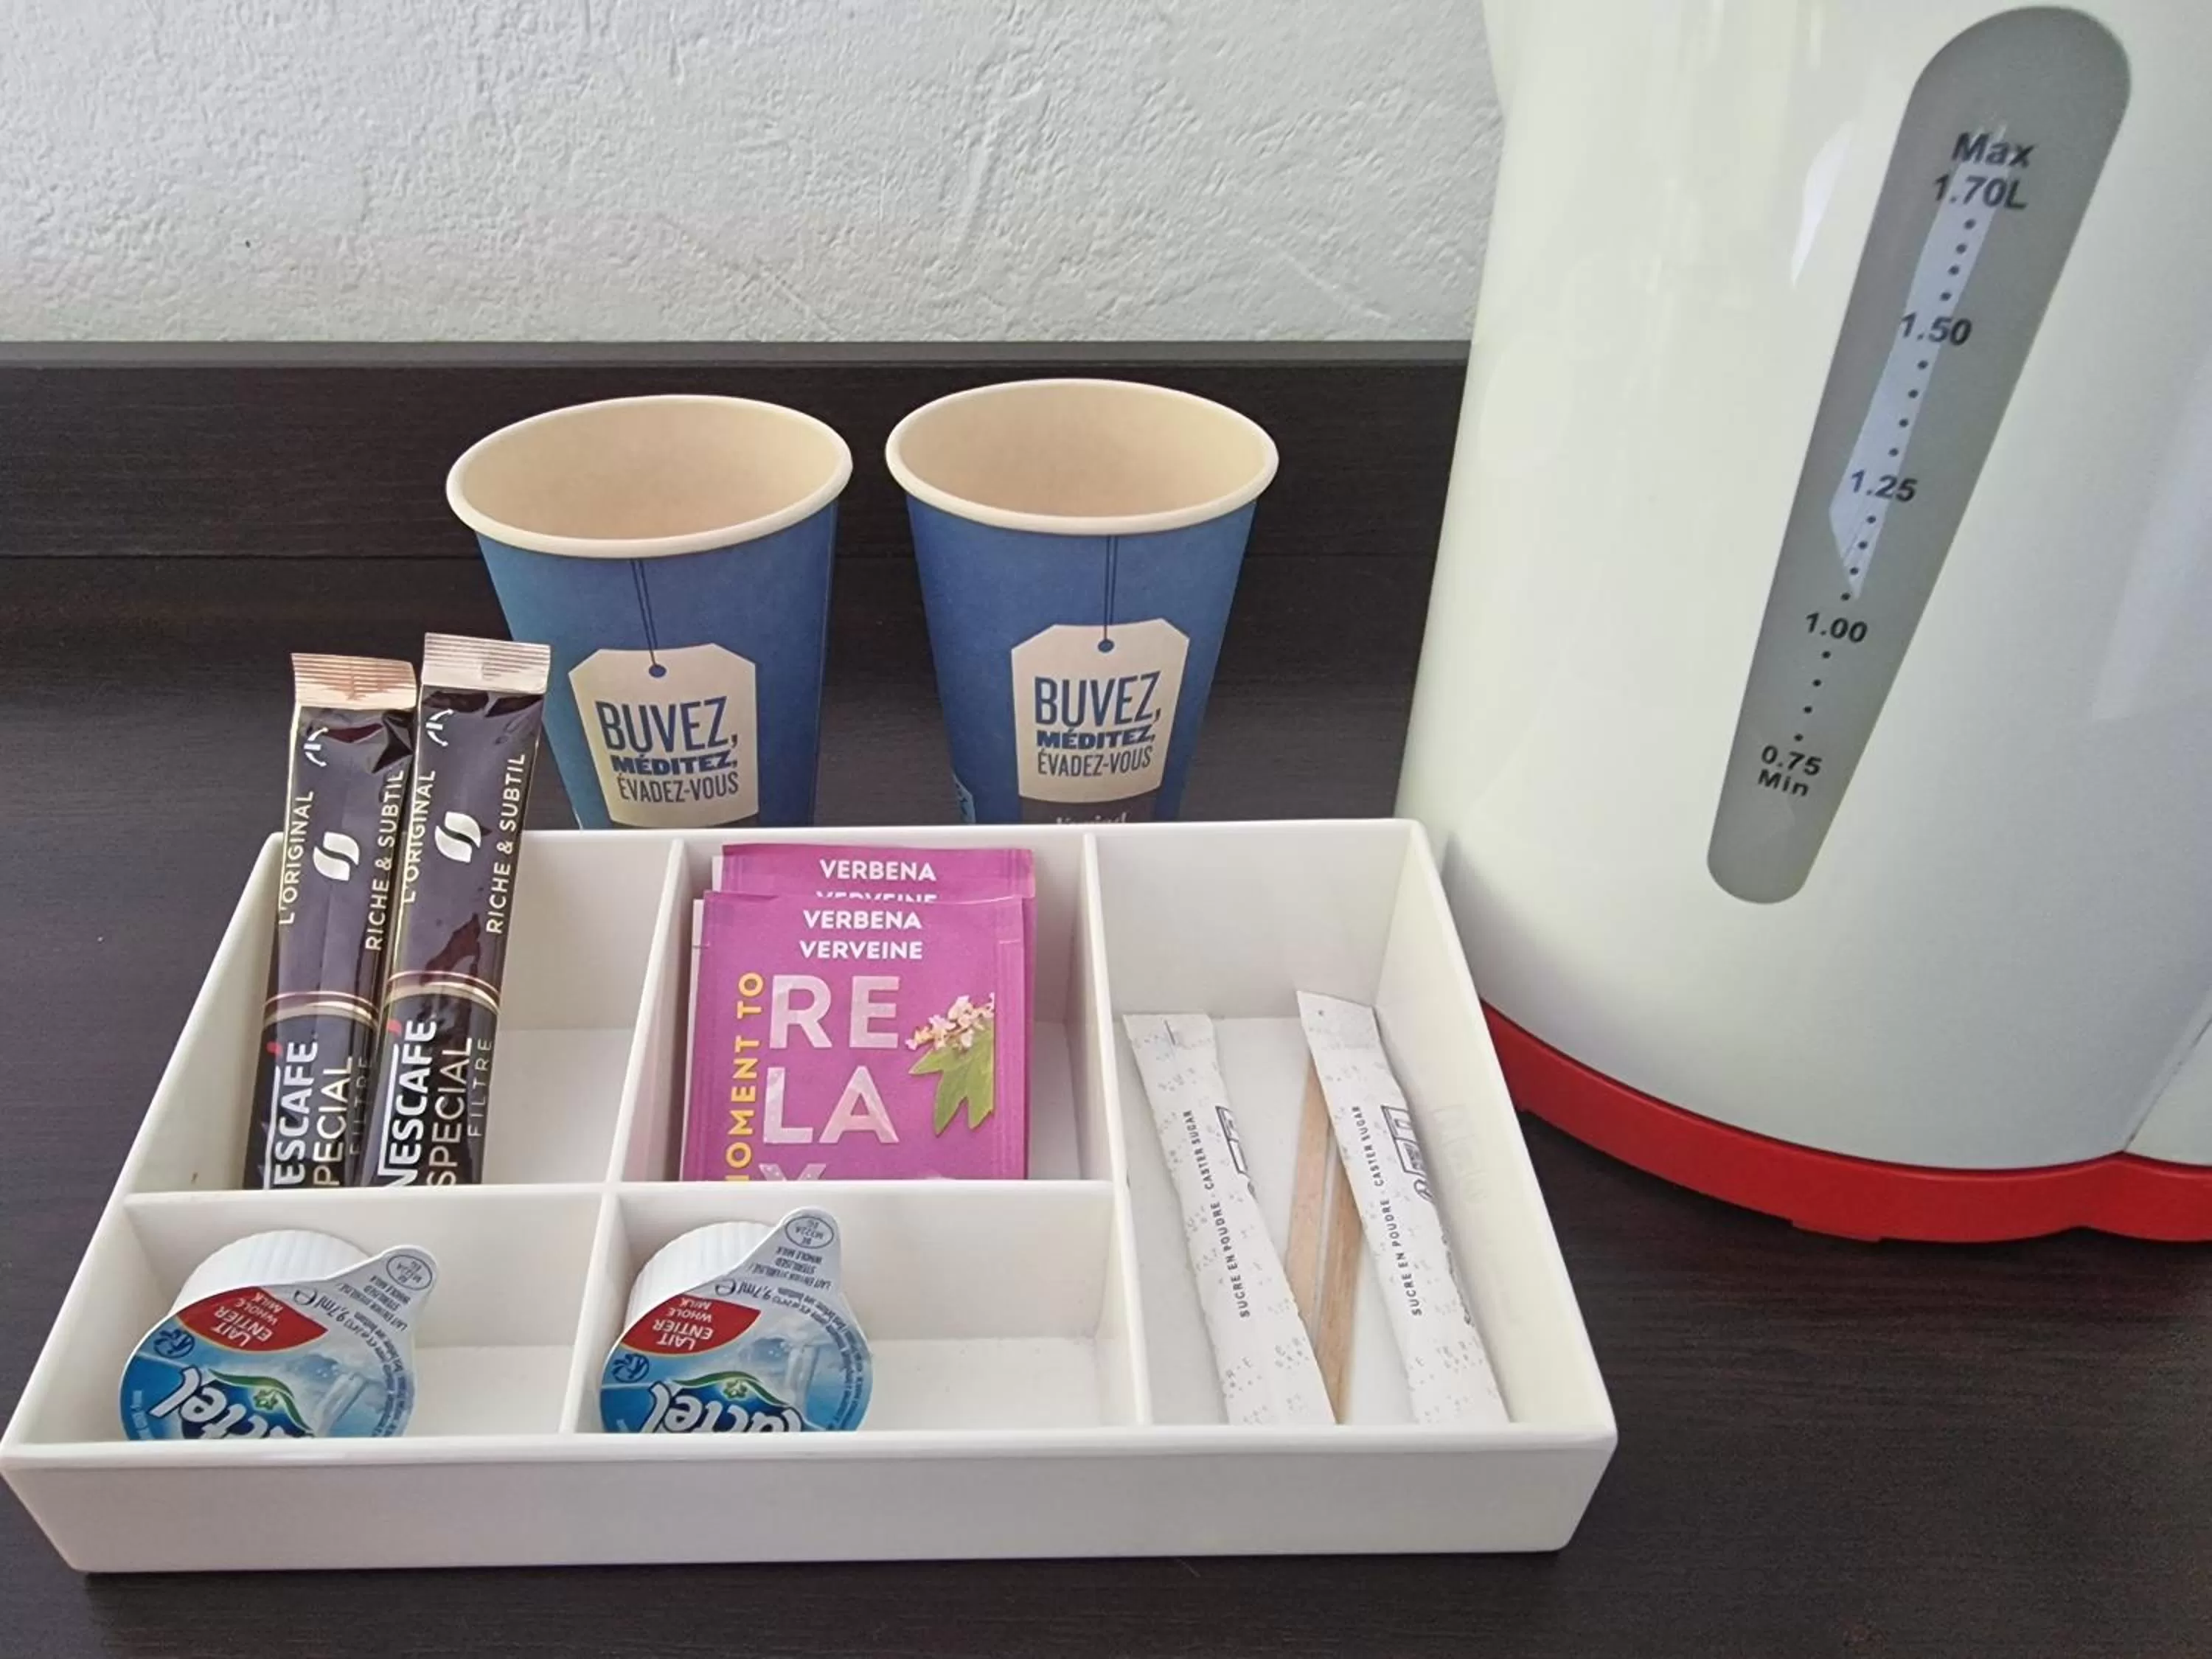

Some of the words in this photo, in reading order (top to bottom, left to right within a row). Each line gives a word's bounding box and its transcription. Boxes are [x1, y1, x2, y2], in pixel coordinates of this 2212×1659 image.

[1952, 131, 2037, 168] Max
[1933, 173, 2028, 210] 1.70L
[1900, 313, 1972, 347] 1.50
[1850, 470, 1918, 503] 1.25
[1806, 612, 1868, 643] 1.00
[1034, 670, 1161, 727] BUVEZ,
[595, 695, 738, 753] BUVEZ,
[1037, 726, 1156, 751] MÉDITEZ,
[611, 750, 737, 776] MÉDITEZ,
[1037, 746, 1152, 777] ÉVADEZ-VOUS
[1761, 745, 1823, 776] 0.75
[500, 754, 526, 833] SUBTIL
[617, 771, 739, 803] ÉVADEZ-VOUS
[1758, 768, 1809, 797] Min
[379, 770, 405, 848] SUBTIL
[400, 771, 436, 905] L'ORIGINAL
[497, 841, 514, 855] &
[279, 790, 314, 925] L'ORIGINAL
[375, 855, 393, 872] &
[819, 859, 937, 882] VERBENA
[365, 878, 390, 951] RICHE
[487, 861, 511, 934] RICHE
[803, 910, 922, 931] VERBENA
[799, 940, 923, 959] VERVEINE
[737, 972, 765, 1019] TO
[769, 974, 901, 1049] RE
[467, 1039, 493, 1137] FILTRE
[762, 1065, 900, 1144] LA
[312, 1055, 353, 1186] PECIAL
[724, 1034, 762, 1181] OMENT
[1352, 1107, 1371, 1141] SUGAR
[1183, 1110, 1202, 1144] SUGAR
[1194, 1147, 1214, 1191] CASTER
[1364, 1144, 1384, 1186] CASTER
[1210, 1201, 1232, 1252] POUDRE
[1380, 1198, 1402, 1247] POUDRE
[1225, 1254, 1237, 1270] EN
[1396, 1253, 1408, 1268] EN
[235, 1298, 279, 1325] WHOLE
[251, 1291, 284, 1314] MILK
[679, 1297, 713, 1310] MILK
[1231, 1274, 1251, 1318] SUCRE
[1402, 1273, 1422, 1316] SUCRE
[214, 1306, 274, 1342] ENTIER
[652, 1318, 714, 1340] ENTIER
[667, 1307, 713, 1323] WHOLE
[211, 1322, 253, 1348] LAIT
[655, 1332, 697, 1352] LAIT
